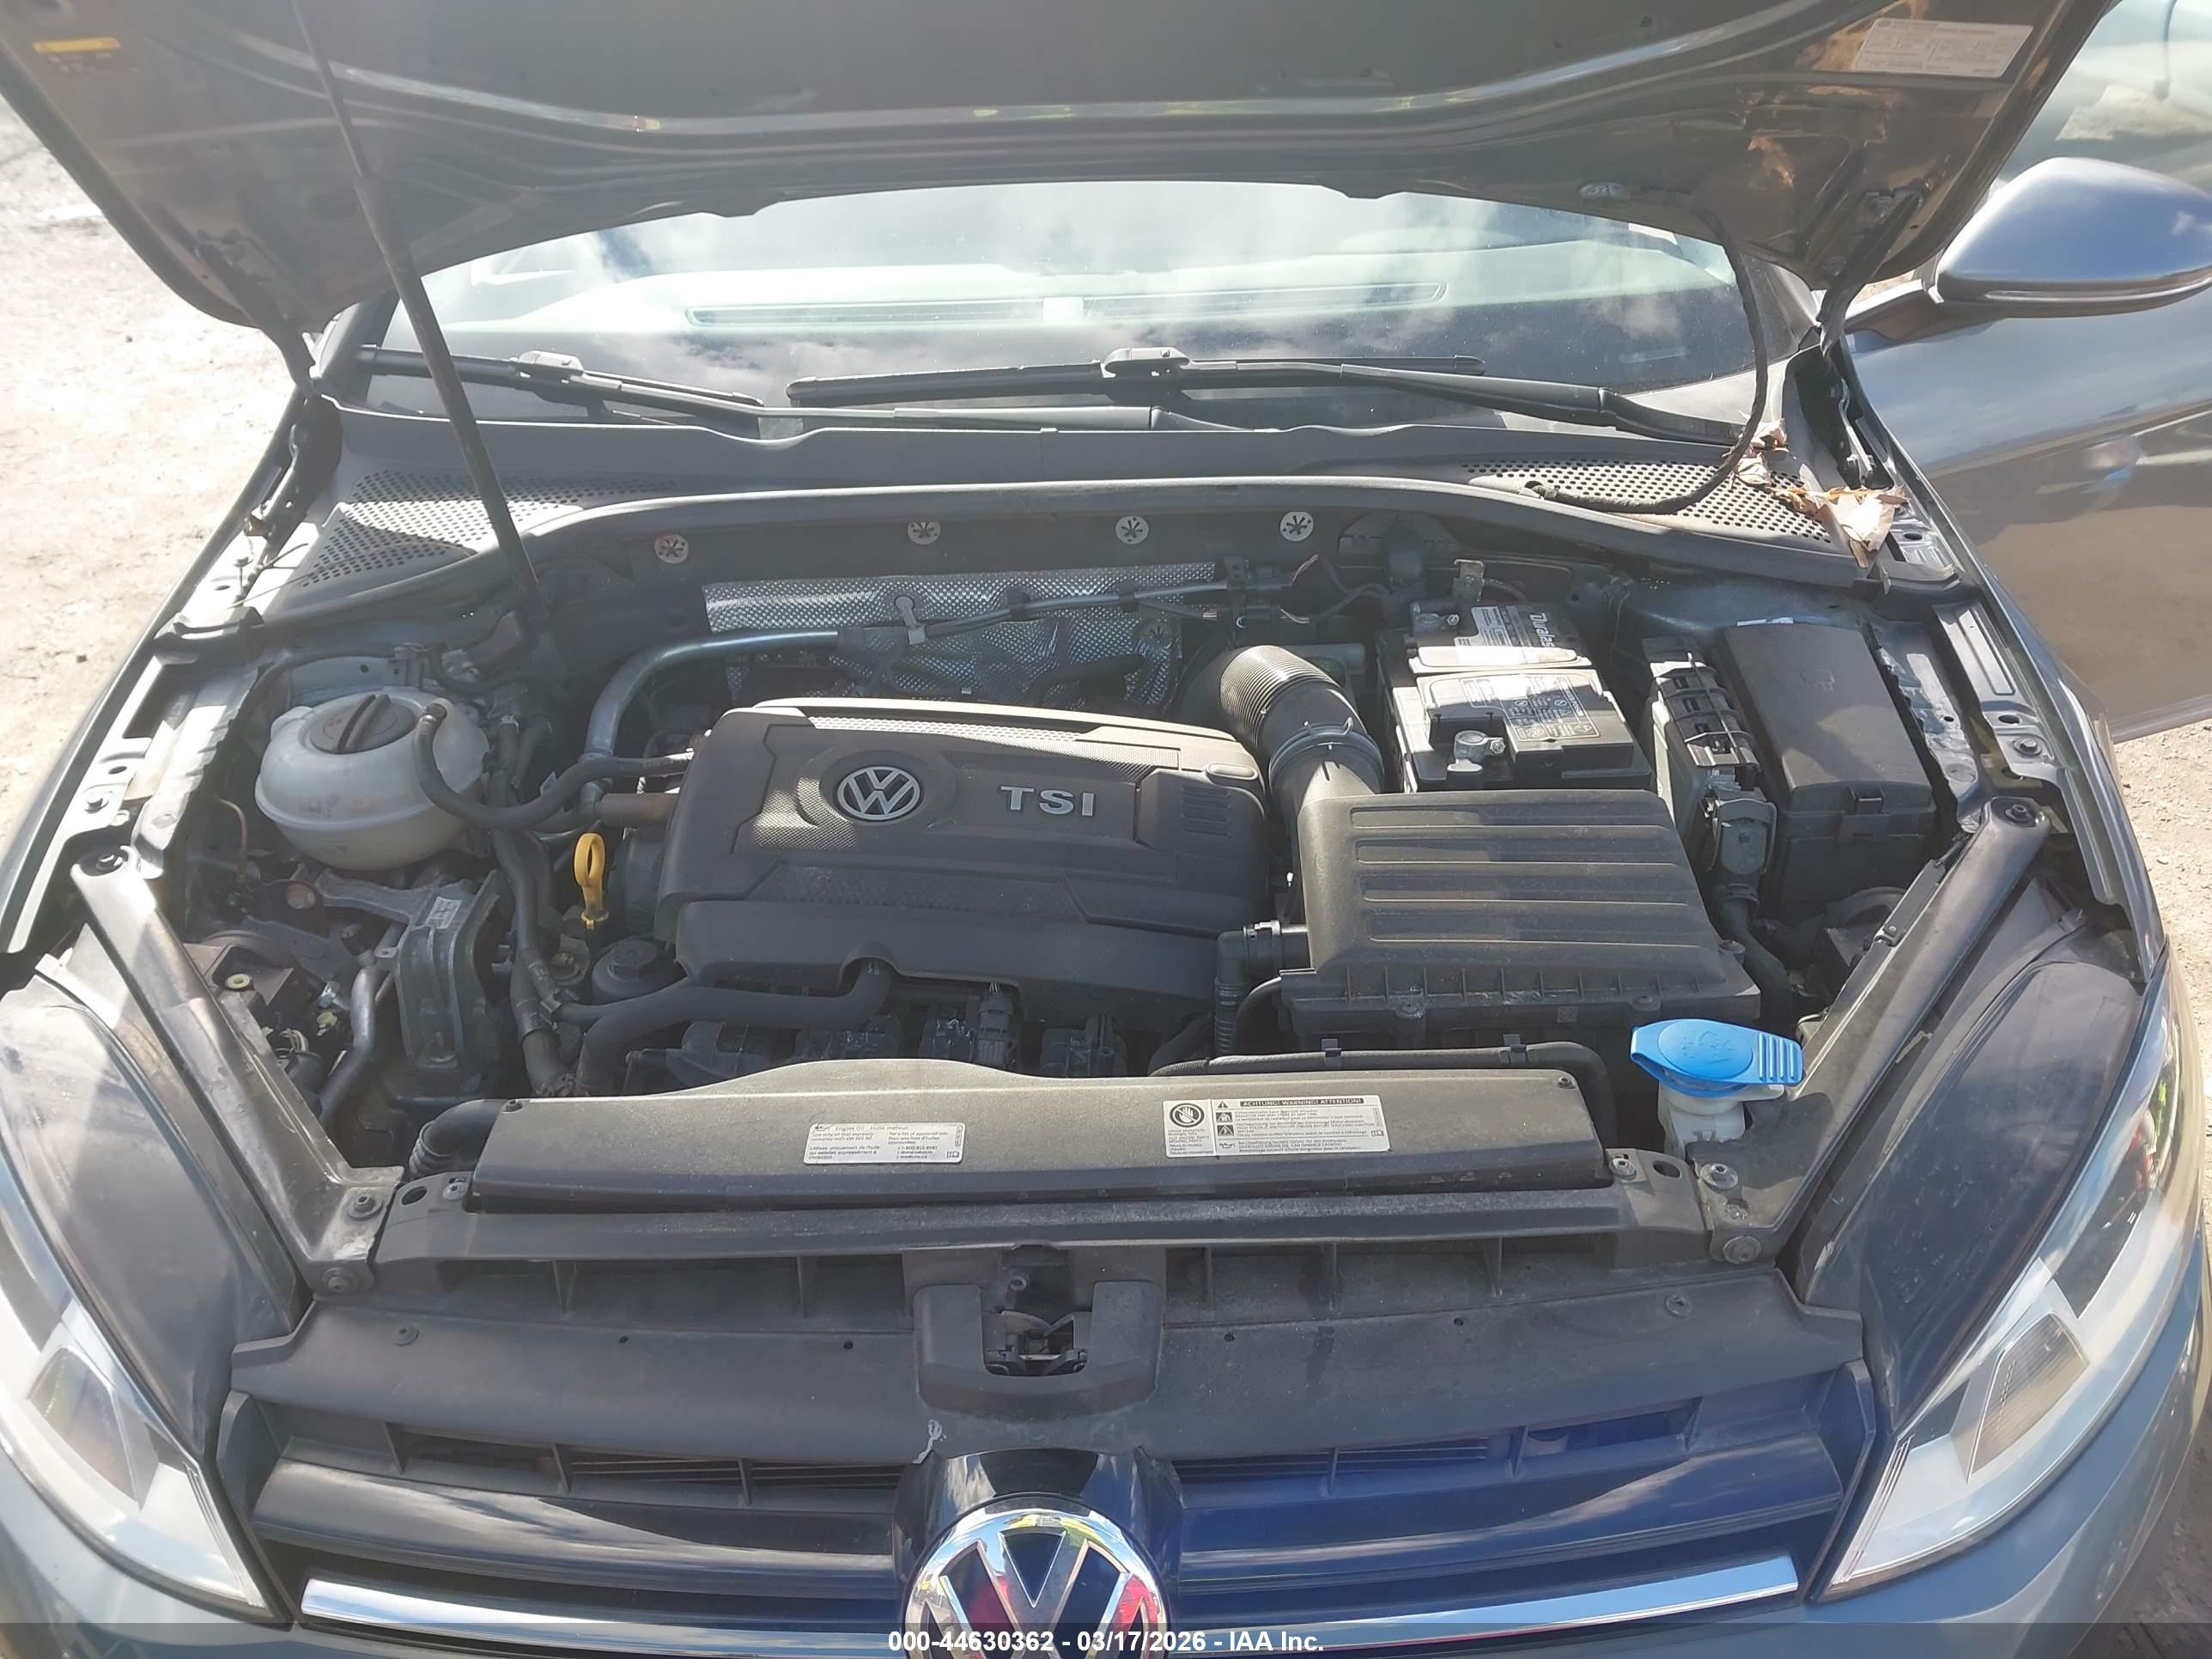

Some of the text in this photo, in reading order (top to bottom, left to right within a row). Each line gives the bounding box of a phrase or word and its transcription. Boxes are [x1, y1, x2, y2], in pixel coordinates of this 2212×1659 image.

[1528, 612, 1556, 647] Duralas
[838, 766, 920, 821] VW
[1000, 785, 1095, 817] TSI
